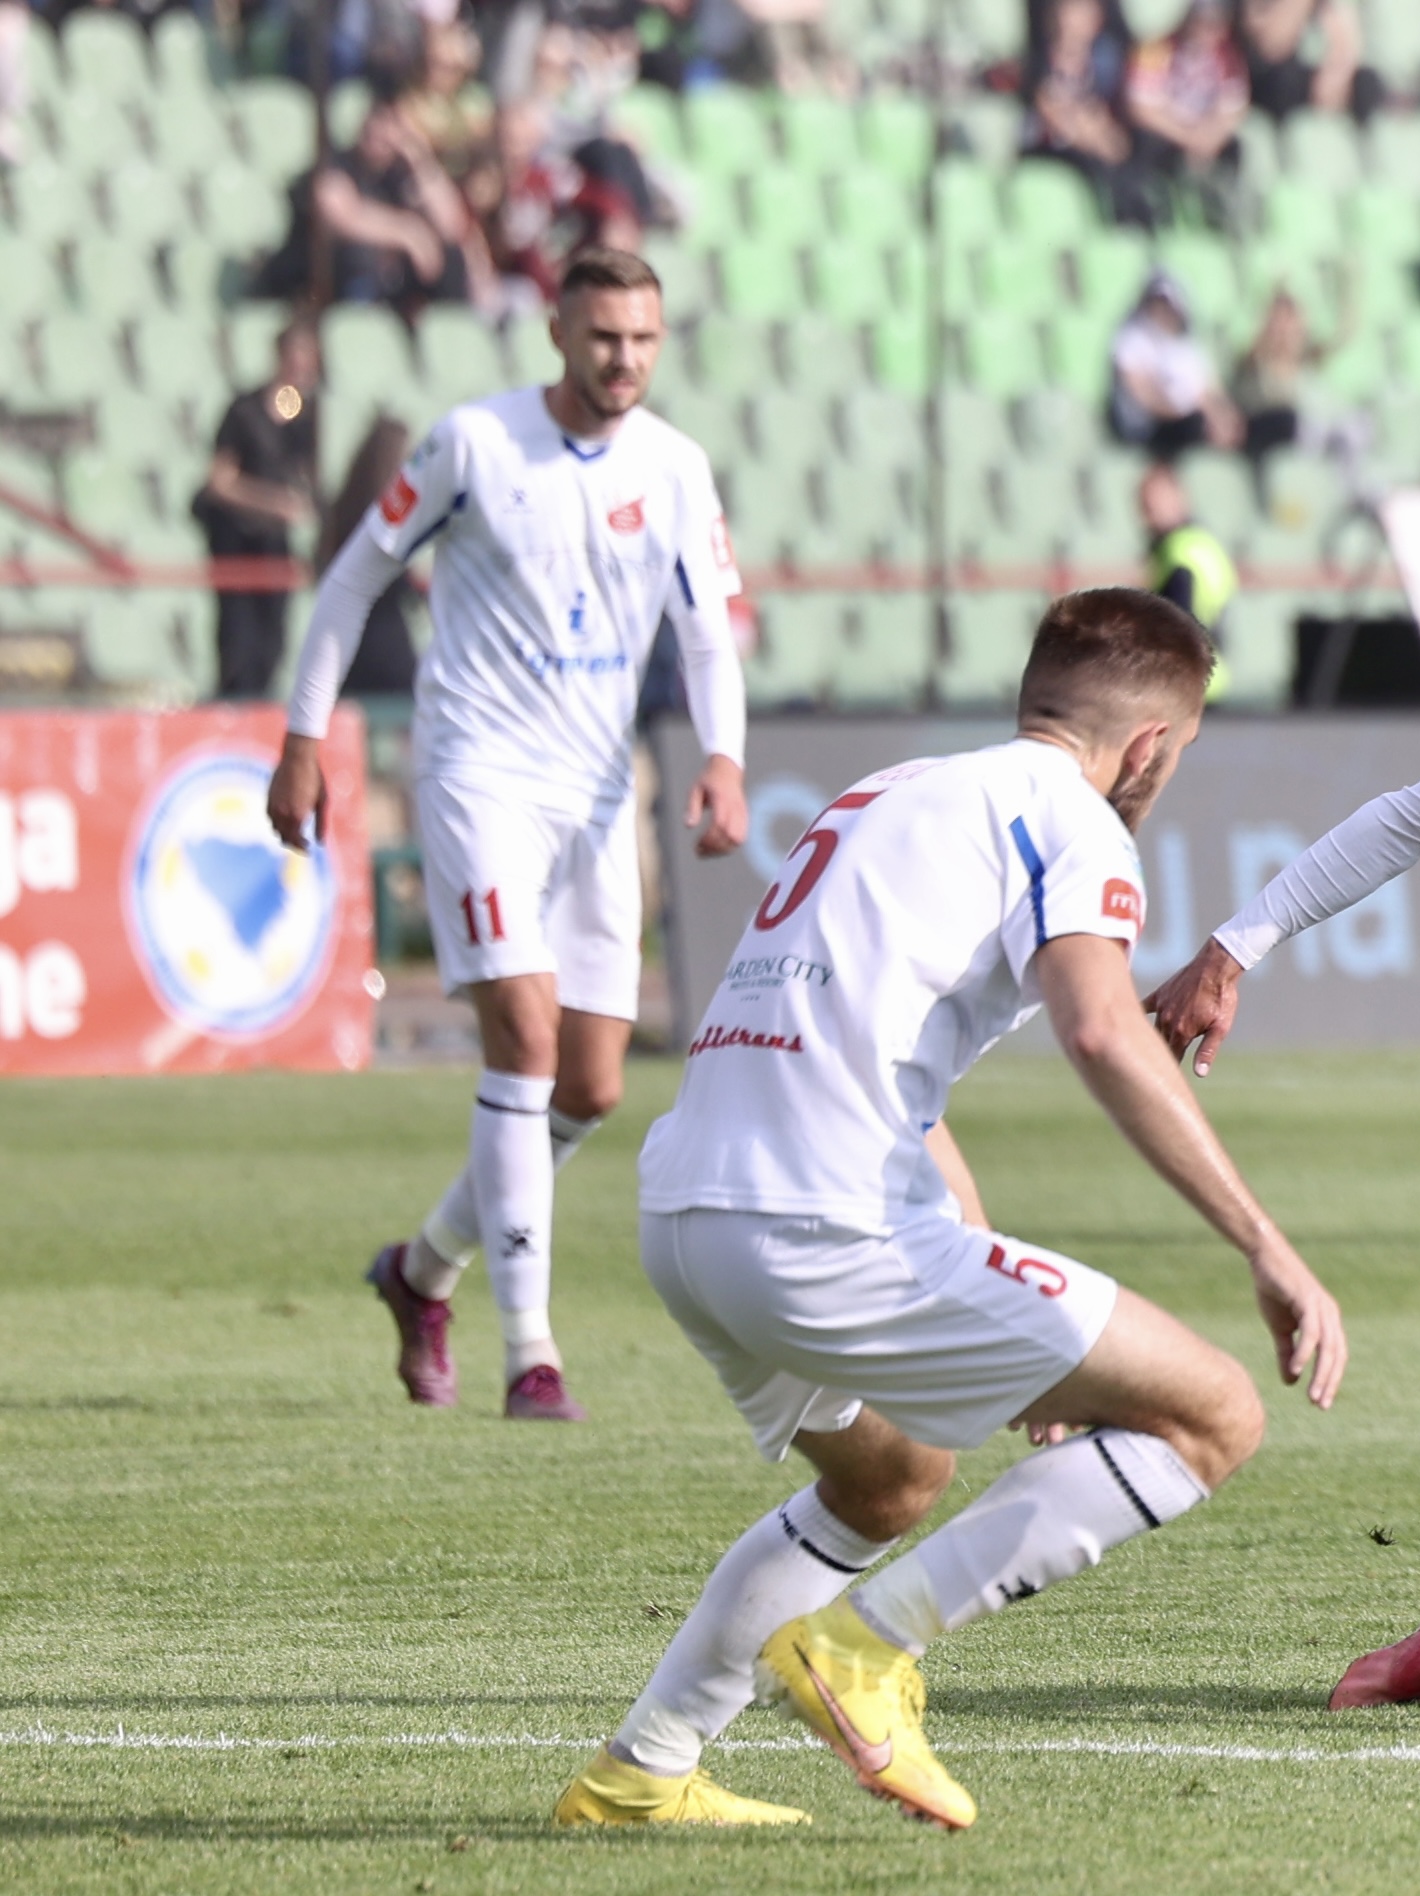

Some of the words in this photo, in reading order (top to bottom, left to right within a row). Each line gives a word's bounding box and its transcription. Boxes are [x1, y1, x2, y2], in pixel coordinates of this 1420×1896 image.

[754, 788, 888, 932] 5
[461, 886, 506, 947] 11
[778, 955, 834, 987] CITY
[986, 1242, 1068, 1298] 5
